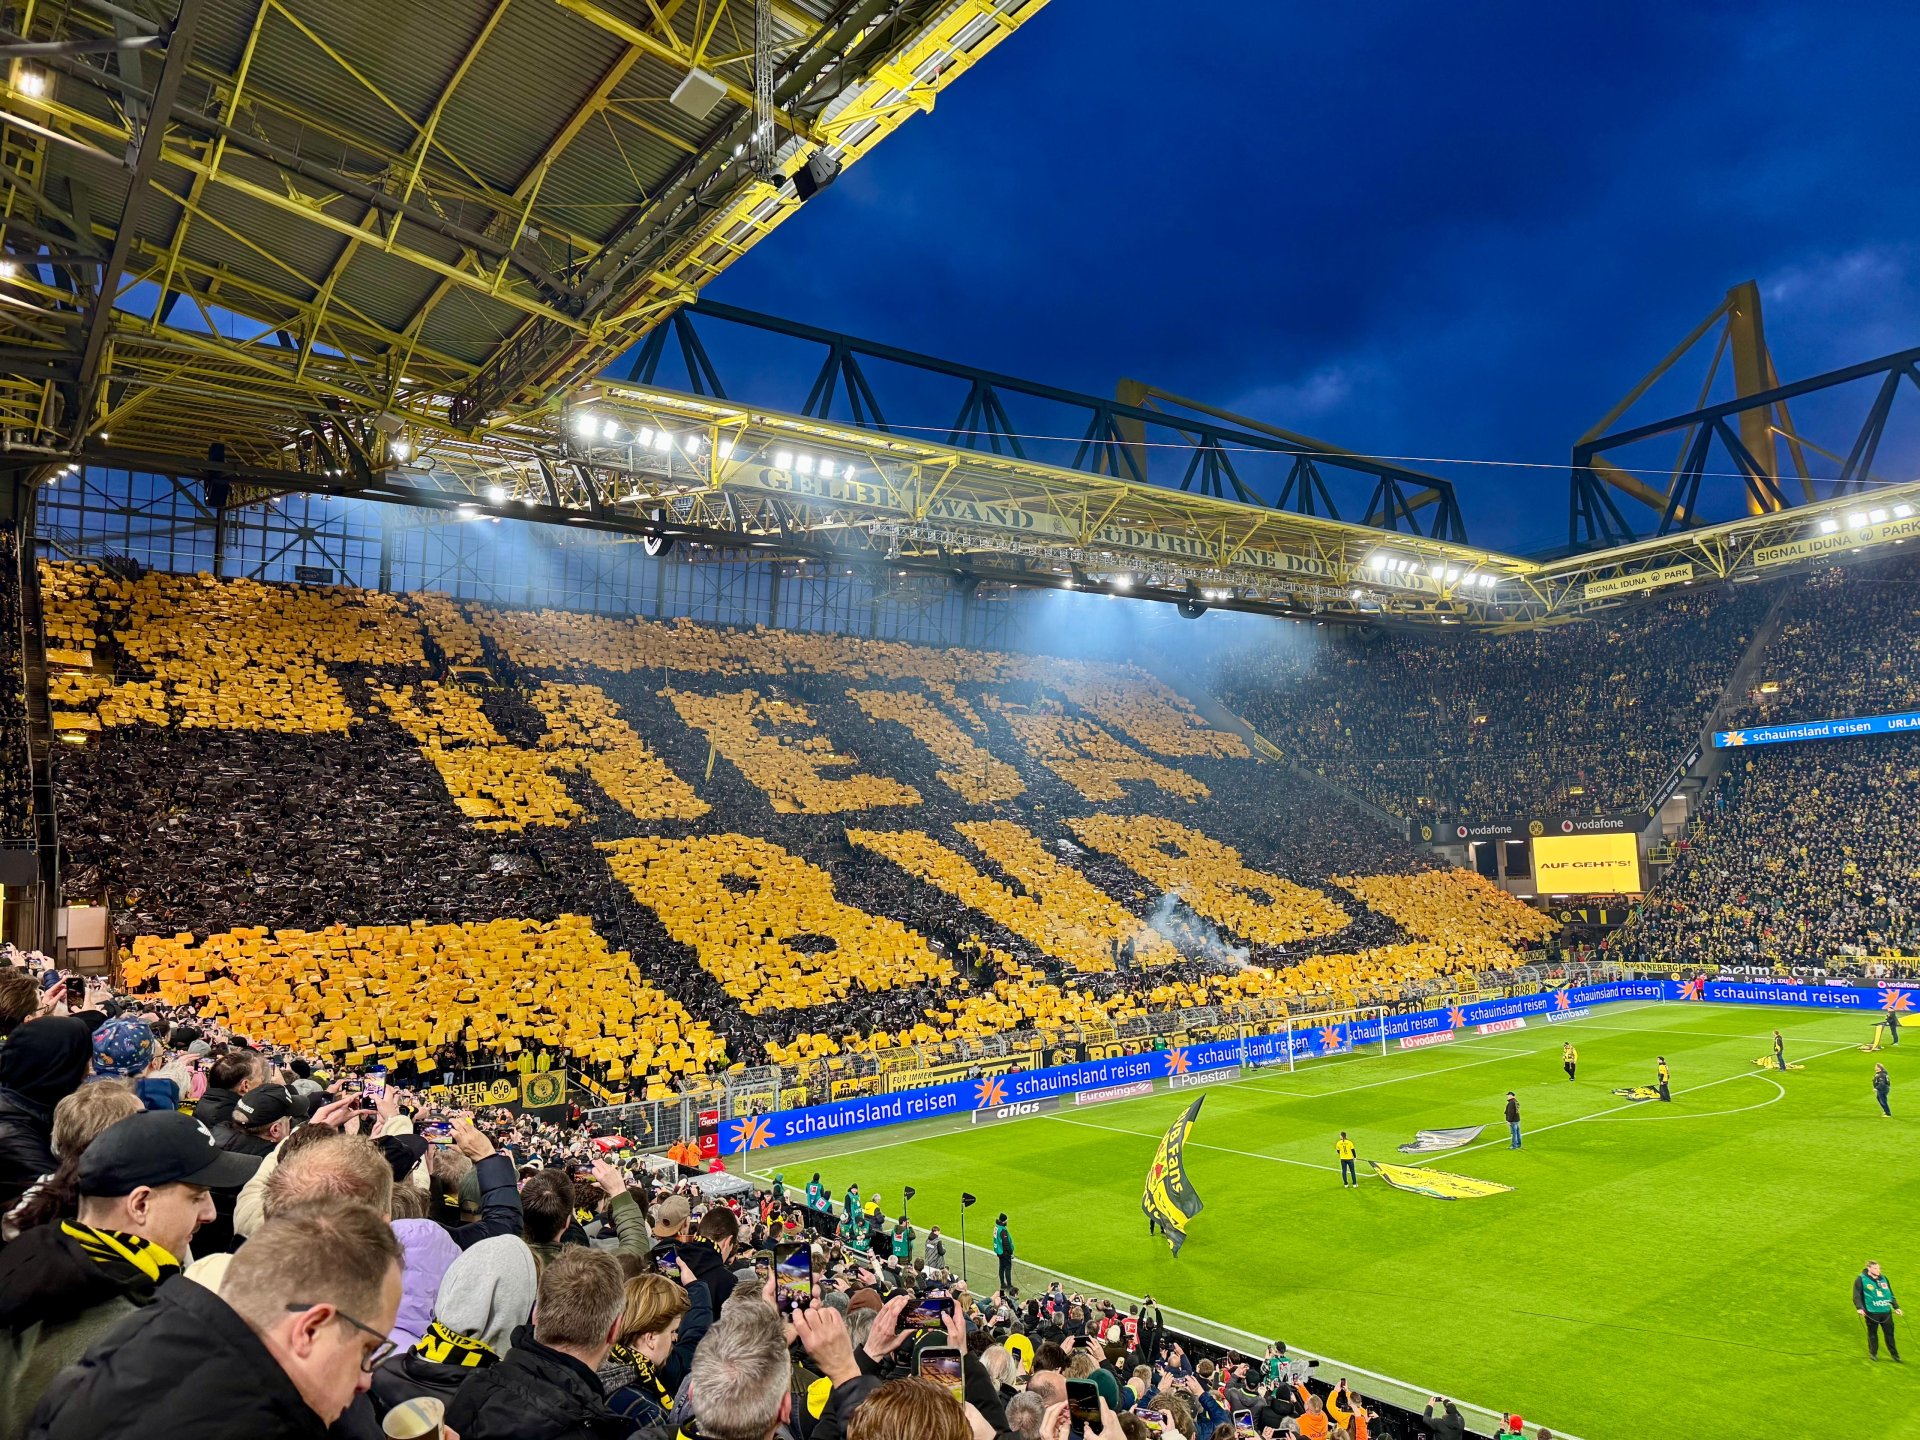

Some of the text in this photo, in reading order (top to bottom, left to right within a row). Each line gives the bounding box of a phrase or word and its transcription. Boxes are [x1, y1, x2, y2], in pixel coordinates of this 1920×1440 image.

[929, 497, 1036, 530] WAND
[1757, 521, 1920, 564] SIGNAL IDUNA PARK
[1588, 567, 1690, 596] SIGNAL IDUNA PARK
[1752, 724, 1830, 742] schauinsland
[1832, 721, 1872, 735] reisen
[1469, 824, 1513, 836] vodafone
[1575, 818, 1624, 831] vodafone
[1572, 860, 1632, 868] GEHT'S!
[1573, 983, 1661, 1004] schauinsland reisen
[1887, 980, 1920, 989] vodafone
[1714, 986, 1860, 1005] schauinsland reisen
[1470, 1000, 1523, 1021] schauinsland
[1523, 998, 1547, 1014] reisen
[1551, 1007, 1590, 1022] coinbase
[1349, 1016, 1439, 1042] schauinsland reisen
[1486, 1019, 1518, 1034] ROWE
[1414, 1031, 1453, 1047] vodafone
[1197, 1034, 1309, 1066] schauinsland reisen
[893, 1071, 934, 1085] FÜR IMMER
[1016, 1060, 1152, 1096] schauinsland reisen
[1181, 1067, 1230, 1088] Polestar
[493, 1081, 510, 1095] BVB
[1080, 1084, 1137, 1103] Eurowings
[785, 1100, 901, 1137] schauinsland
[906, 1092, 957, 1115] reisen
[996, 1100, 1040, 1119] atlas
[1168, 1146, 1183, 1193] Fans
